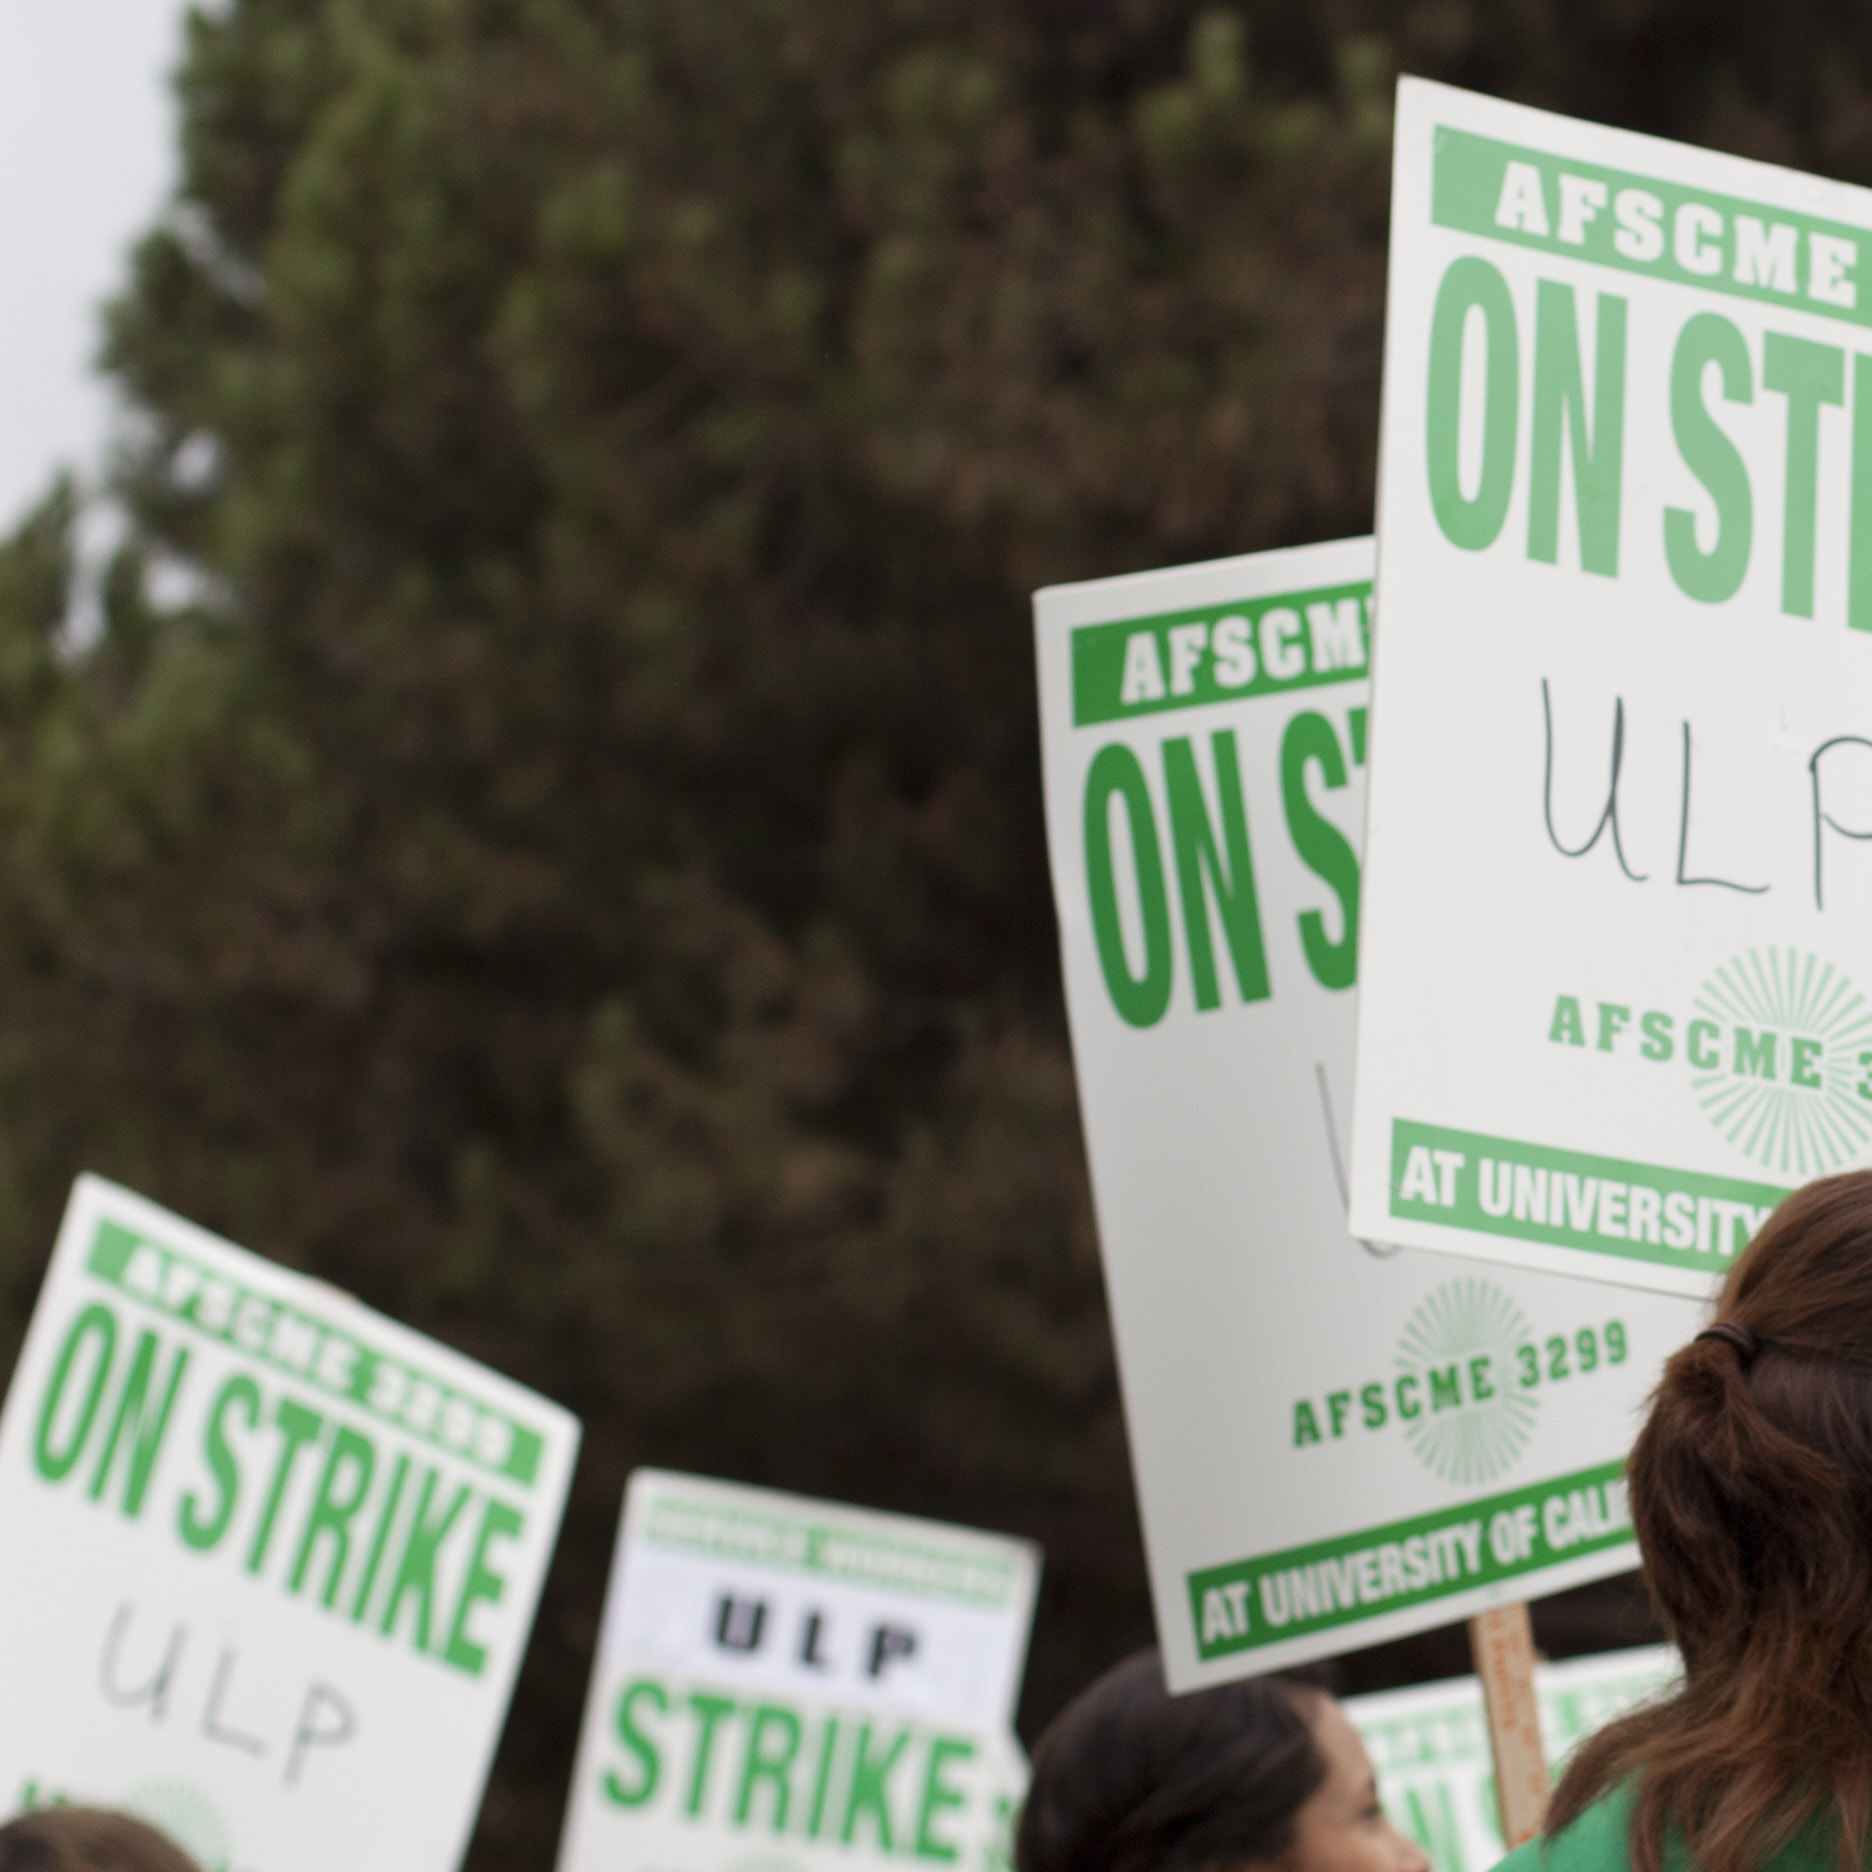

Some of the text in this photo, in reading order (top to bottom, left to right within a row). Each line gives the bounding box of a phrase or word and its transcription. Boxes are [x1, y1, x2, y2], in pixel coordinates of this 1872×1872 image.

[1494, 160, 1859, 308] AFSCME
[1425, 254, 1629, 579] ON
[1119, 592, 1374, 707] AFSCM
[1081, 727, 1273, 1030] ON
[1547, 993, 1825, 1090] AFSCME
[1400, 1144, 1465, 1207] AT
[1292, 1319, 1630, 1448] AFSCME 3299
[31, 1301, 192, 1520] ON
[175, 1369, 526, 1680] STRIKE
[1202, 1580, 1251, 1645] AT
[1258, 1519, 1483, 1628] UNIVERSITY
[1488, 1502, 1538, 1566] OF
[98, 1598, 361, 1790] ULP
[599, 1674, 979, 1866] STRIKE
